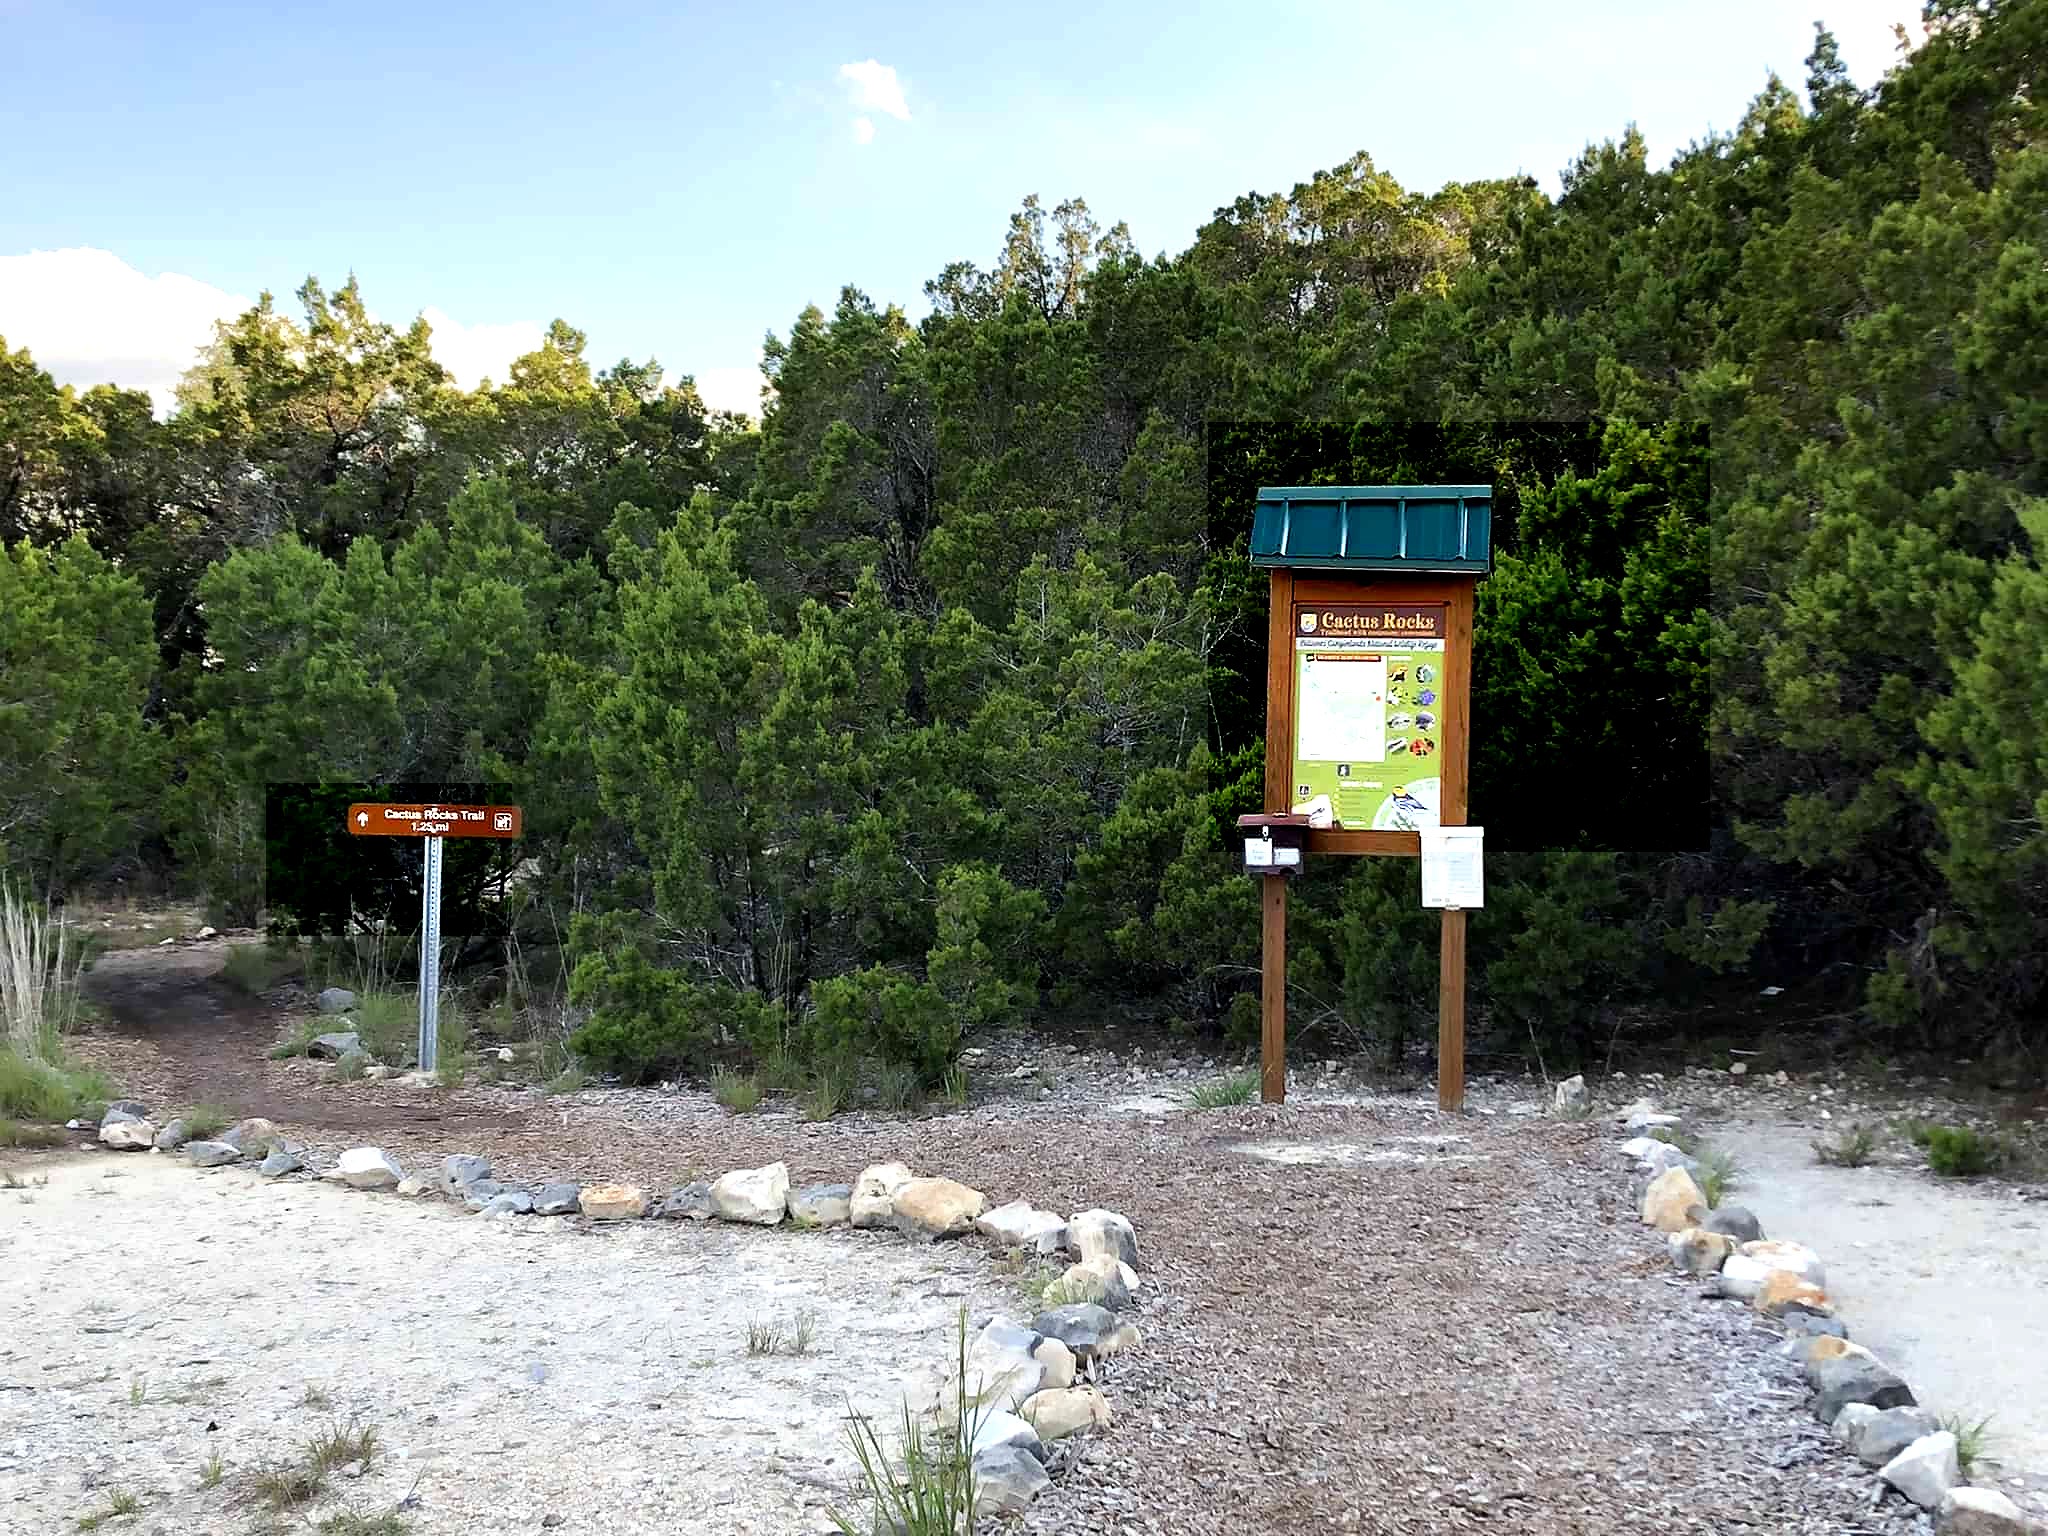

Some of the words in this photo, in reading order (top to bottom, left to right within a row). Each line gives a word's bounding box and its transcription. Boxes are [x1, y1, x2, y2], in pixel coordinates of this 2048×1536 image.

[1322, 612, 1379, 630] Cactus
[1383, 612, 1435, 630] Rocks
[384, 809, 422, 820] Cactus
[424, 809, 459, 820] Rocks
[460, 810, 485, 820] Trail
[411, 822, 433, 832] 1.25
[435, 822, 450, 832] mi
